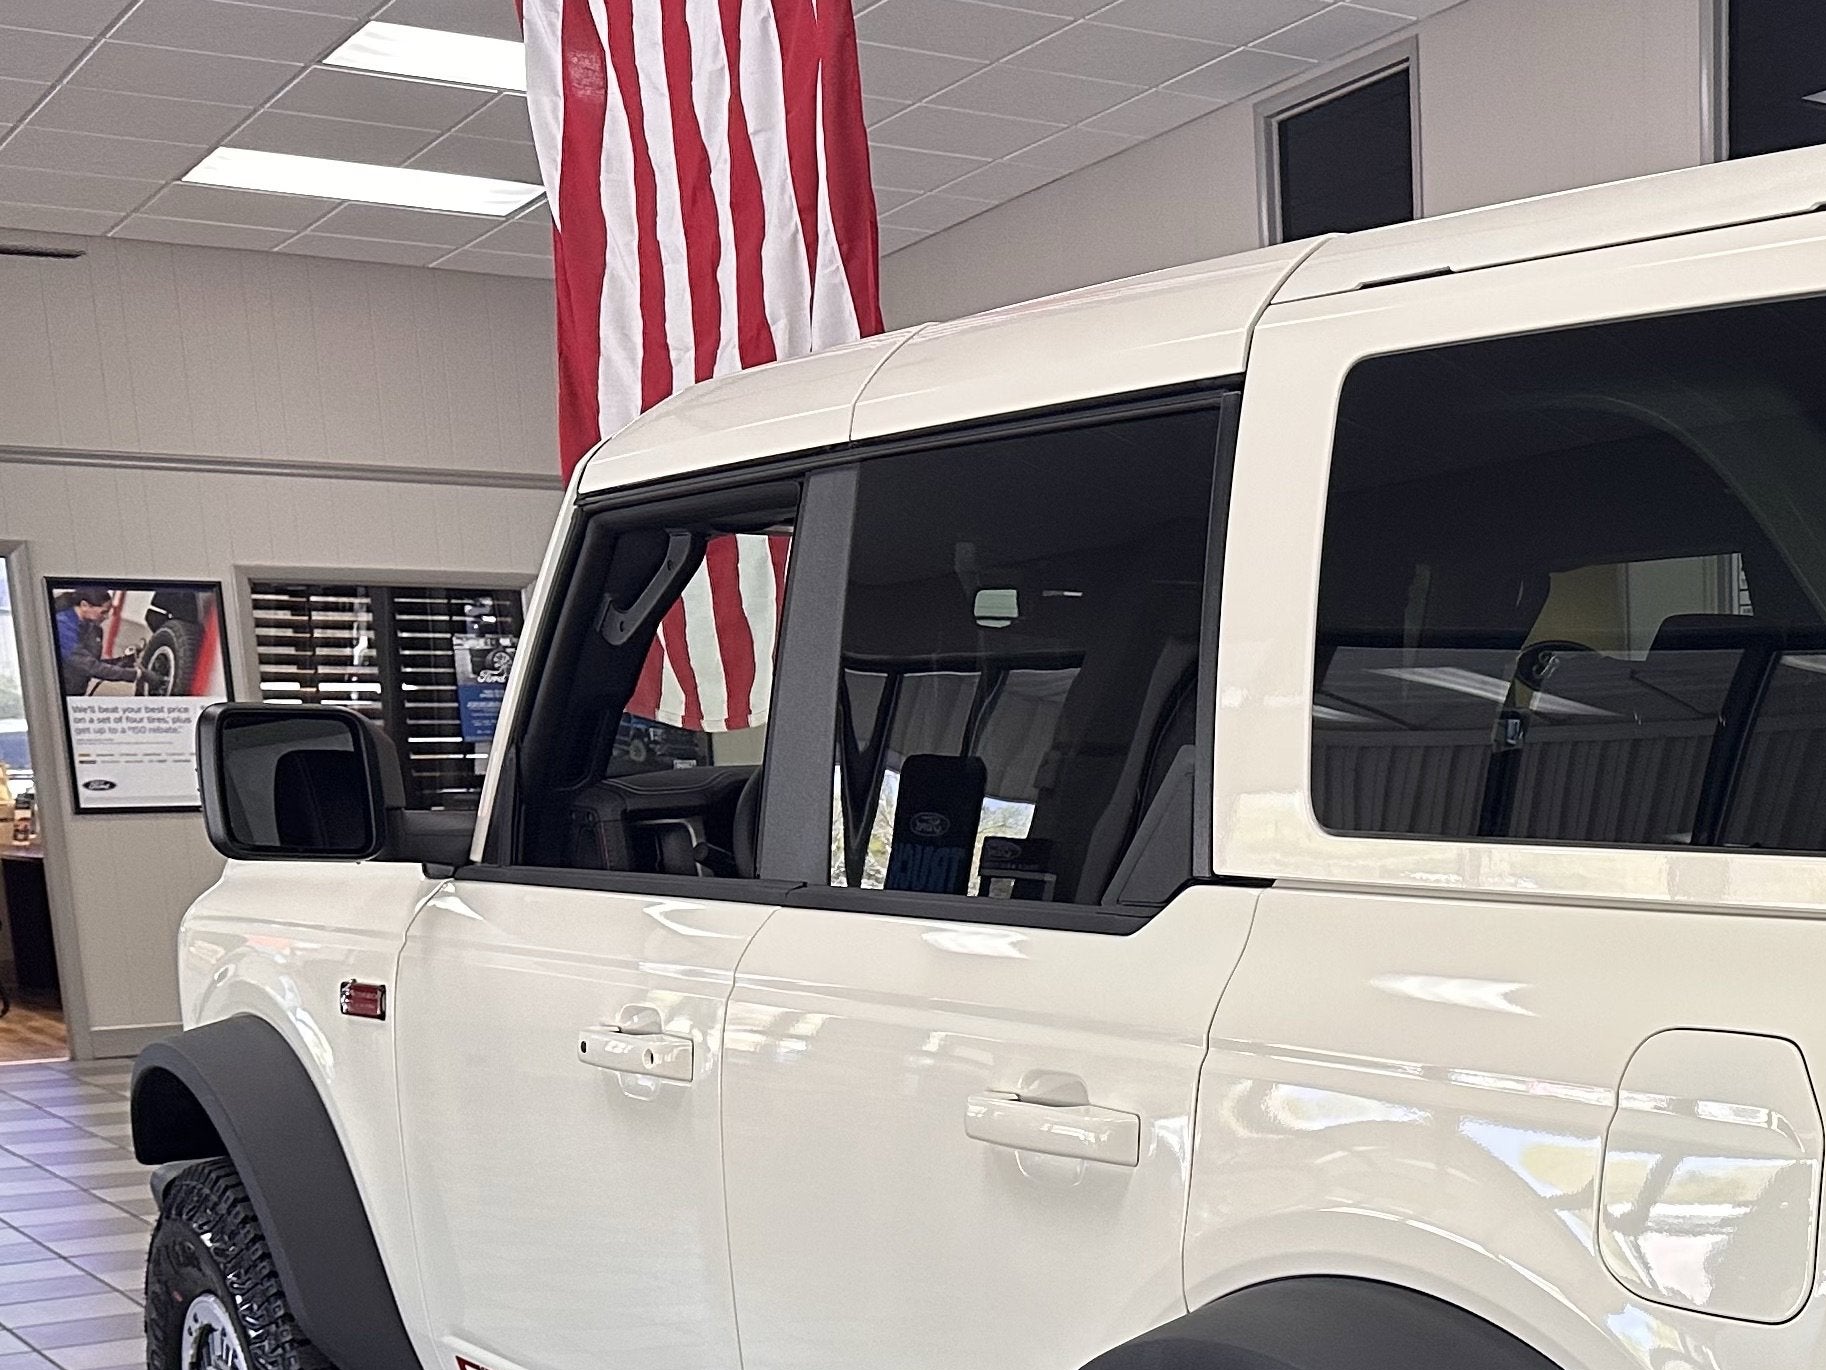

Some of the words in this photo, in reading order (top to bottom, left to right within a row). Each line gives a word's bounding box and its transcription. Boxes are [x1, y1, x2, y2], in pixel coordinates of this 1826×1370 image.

[122, 707, 142, 715] your
[144, 705, 165, 713] best
[167, 706, 189, 714] price
